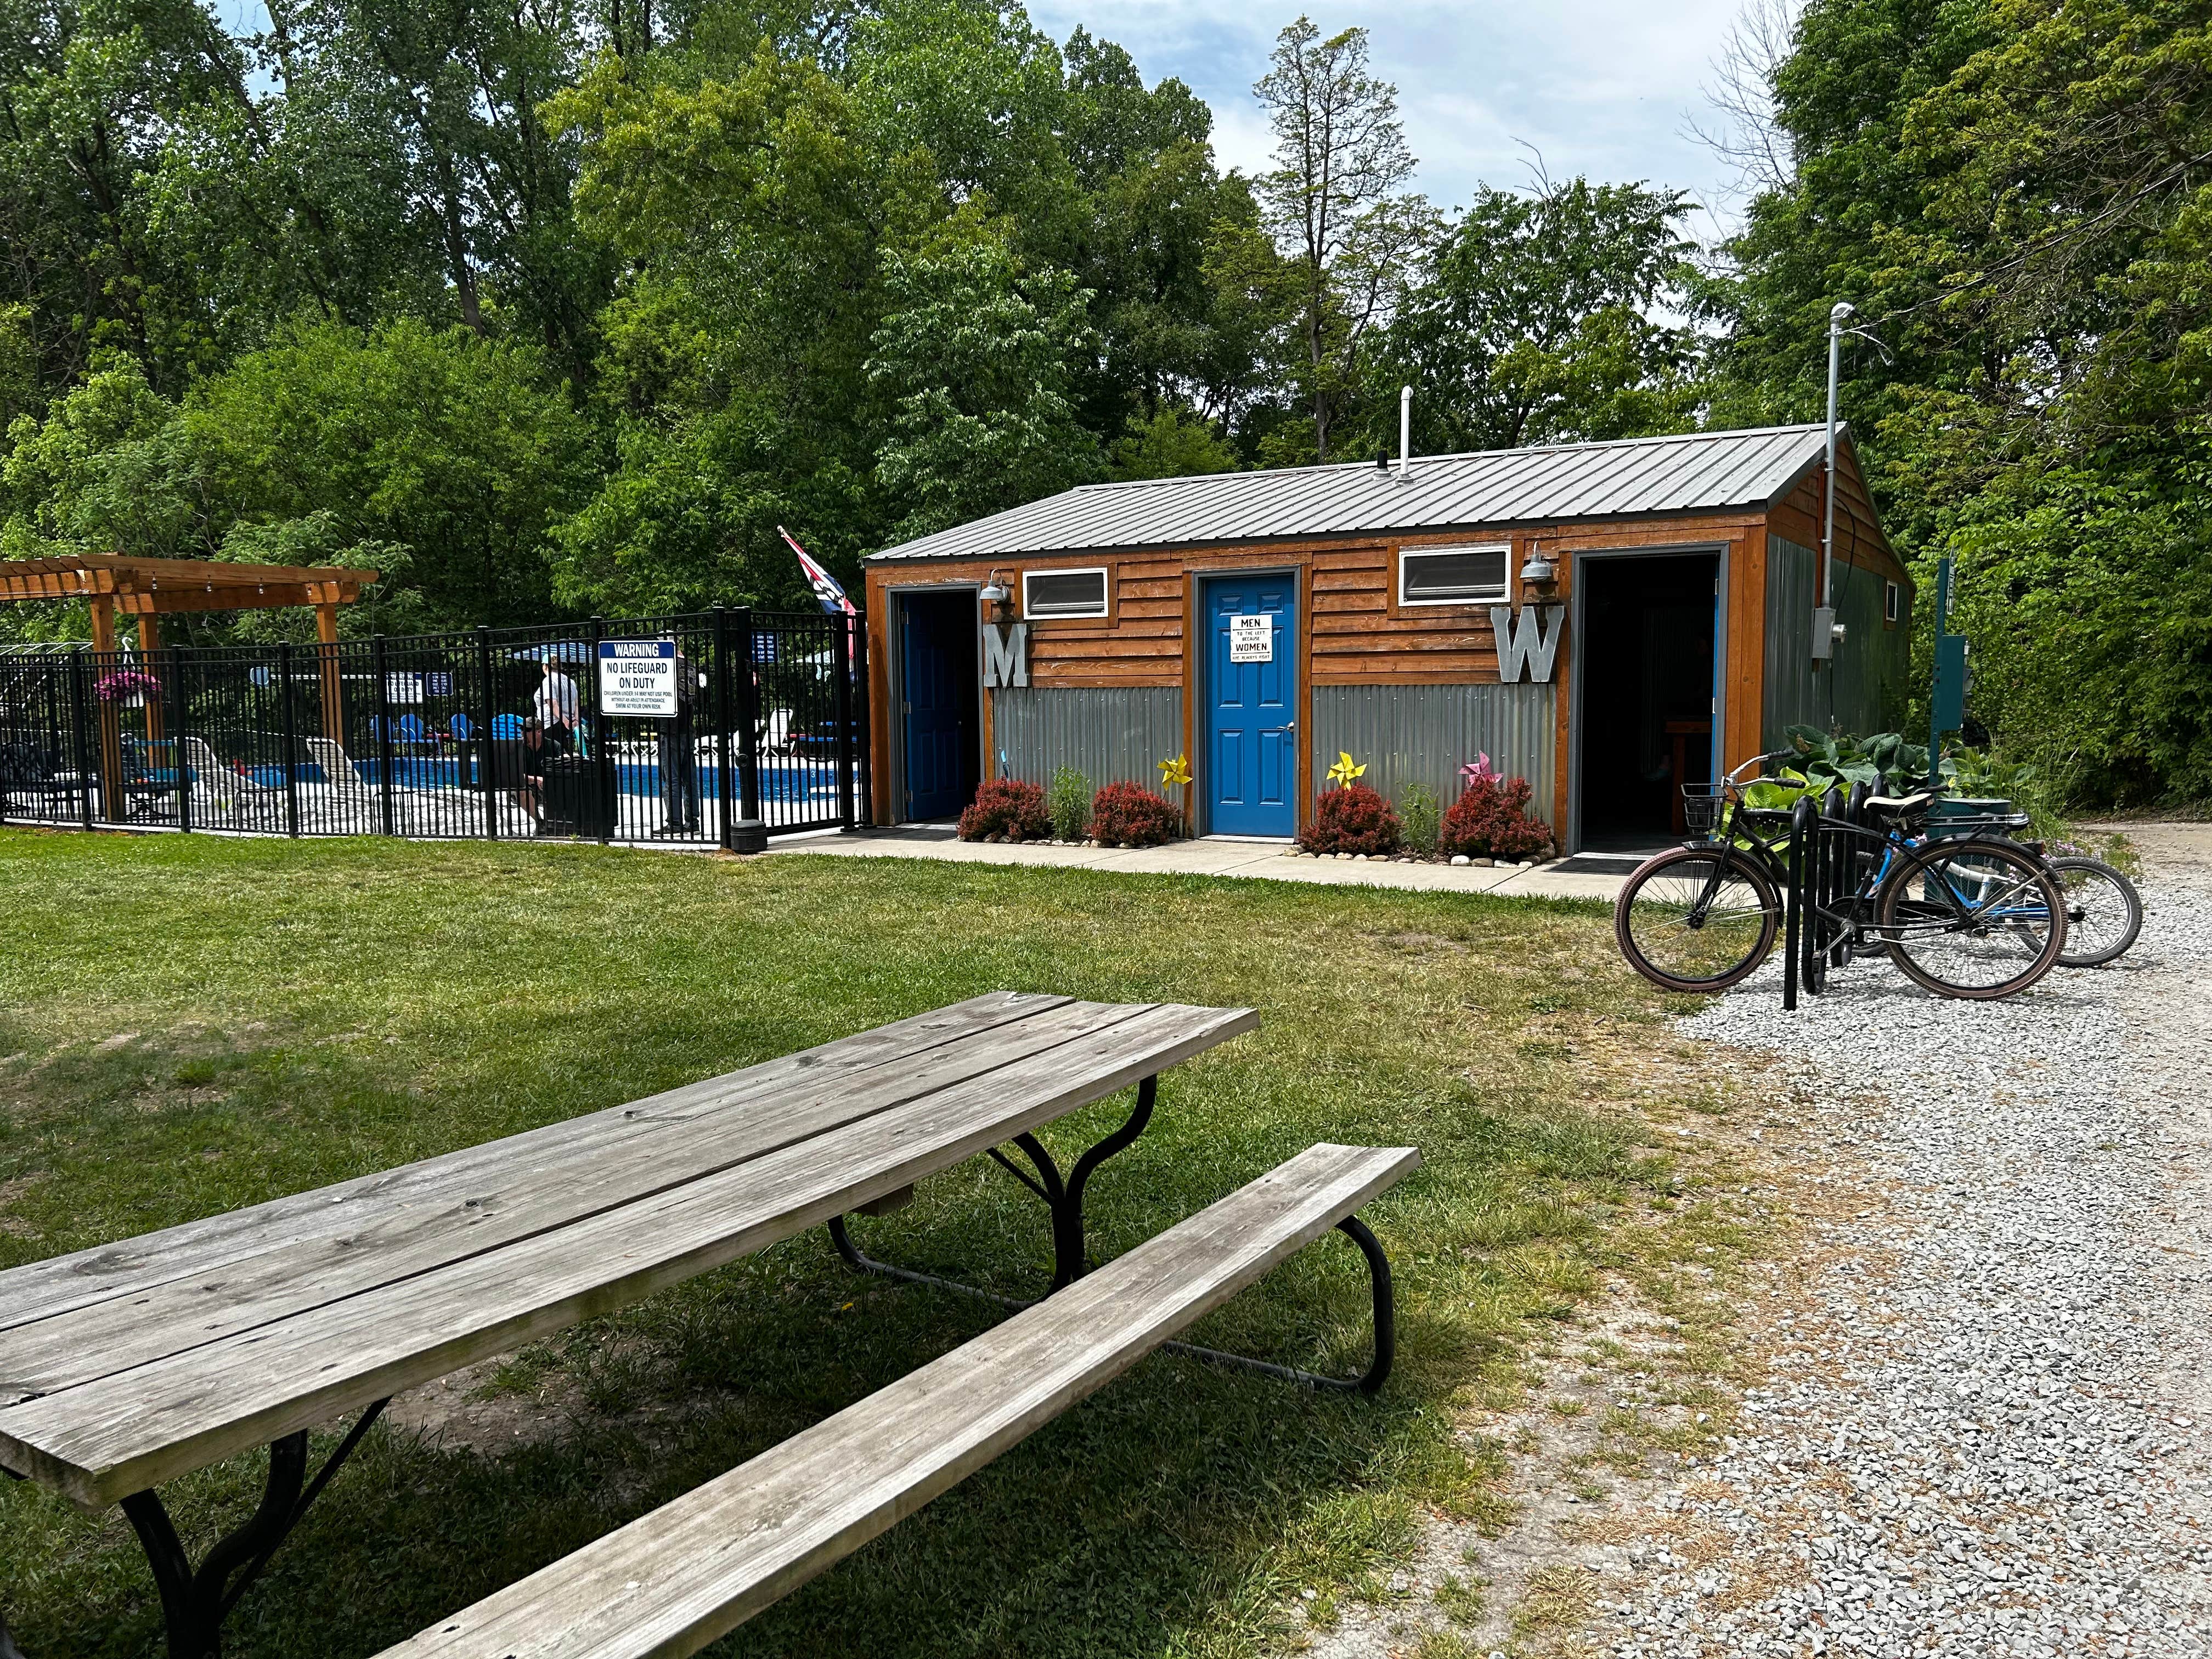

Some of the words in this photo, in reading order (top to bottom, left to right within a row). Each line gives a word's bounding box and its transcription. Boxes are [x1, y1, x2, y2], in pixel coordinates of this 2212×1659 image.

[1241, 618, 1260, 628] MEN
[614, 642, 659, 657] WARNING
[1235, 642, 1267, 652] WOMEN
[1491, 605, 1565, 682] W
[983, 623, 1028, 688] M
[607, 662, 618, 674] NO
[620, 662, 668, 674] LIFEGUARD
[619, 677, 631, 689] ON
[633, 677, 655, 689] DUTY
